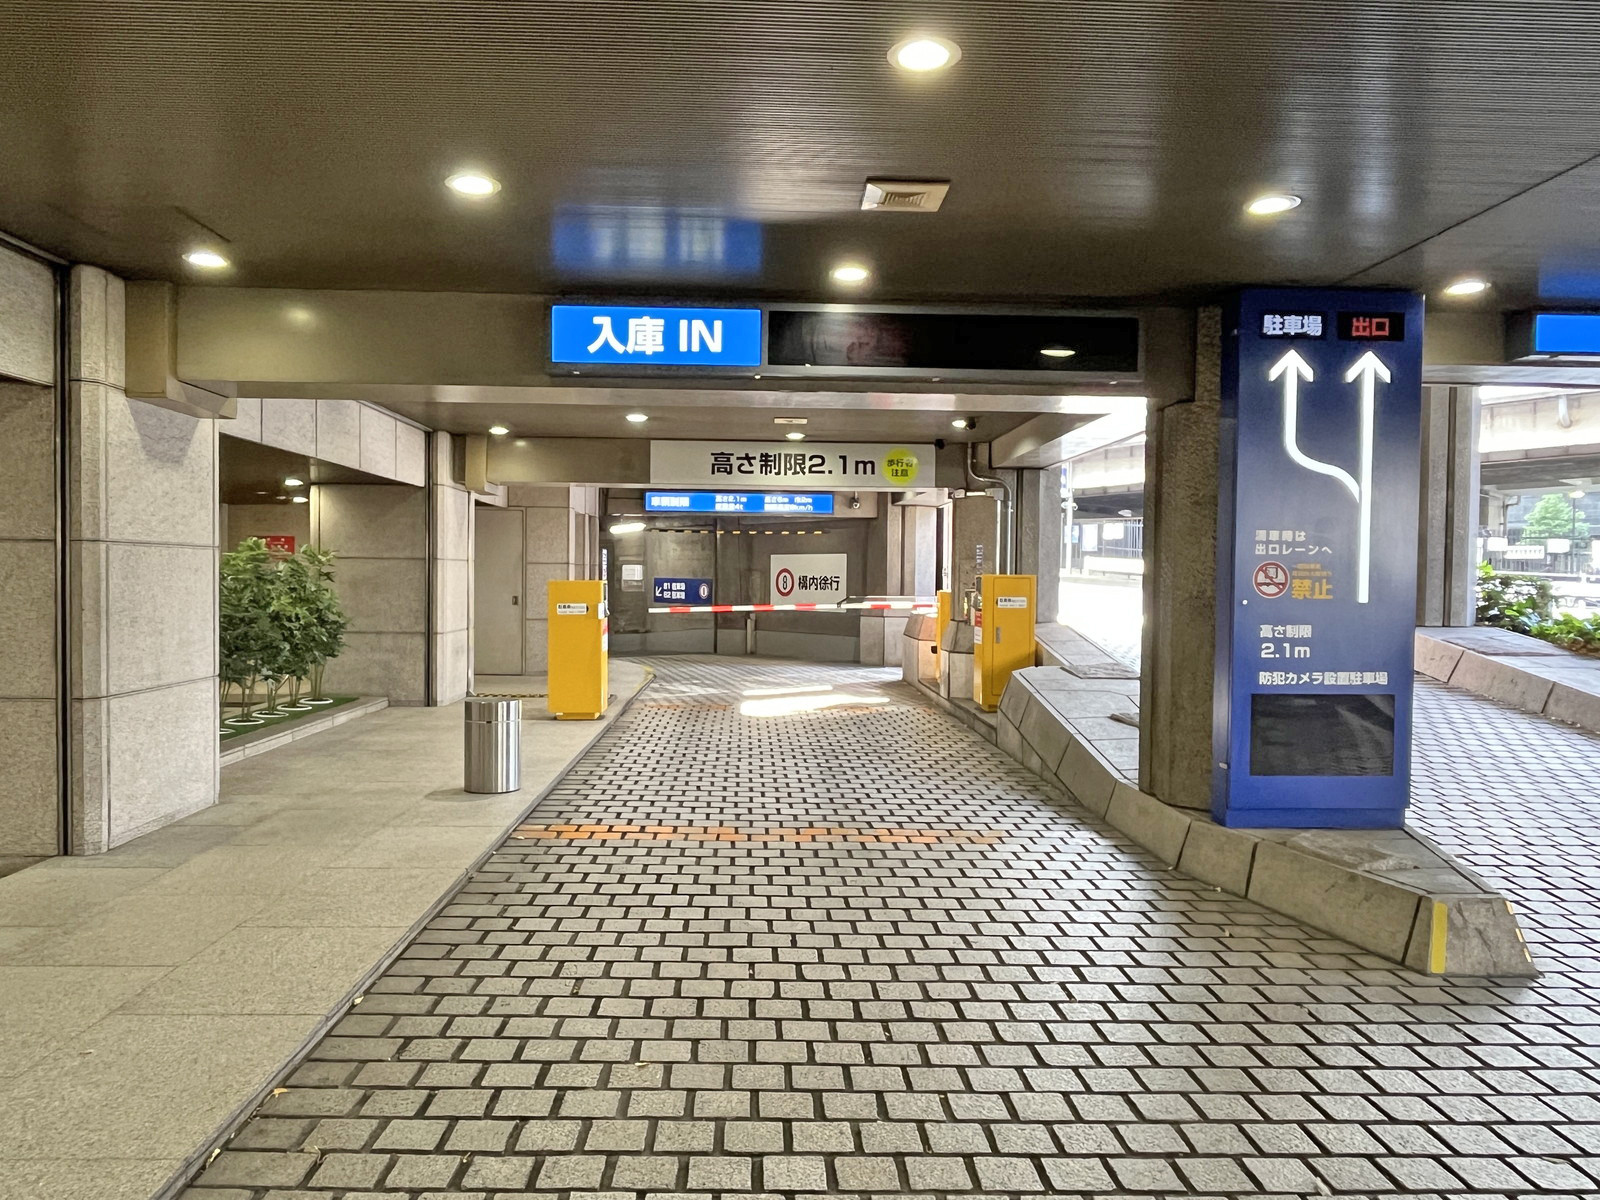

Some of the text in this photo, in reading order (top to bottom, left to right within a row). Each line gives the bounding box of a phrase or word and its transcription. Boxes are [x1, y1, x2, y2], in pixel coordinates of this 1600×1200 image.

[1263, 314, 1322, 336] 駐車場
[1352, 317, 1390, 337] 出口
[587, 316, 723, 355] 入庫 IN
[710, 452, 876, 476] 高さ制限2.1m
[1255, 543, 1333, 555] 出口レーンへ
[798, 574, 841, 591] 構内徐行
[1291, 578, 1334, 599] 禁止
[1260, 624, 1312, 638] 高さ制限
[1260, 642, 1311, 658] 2.1m
[1258, 671, 1389, 686] 防犯カメラ設置駐車場
